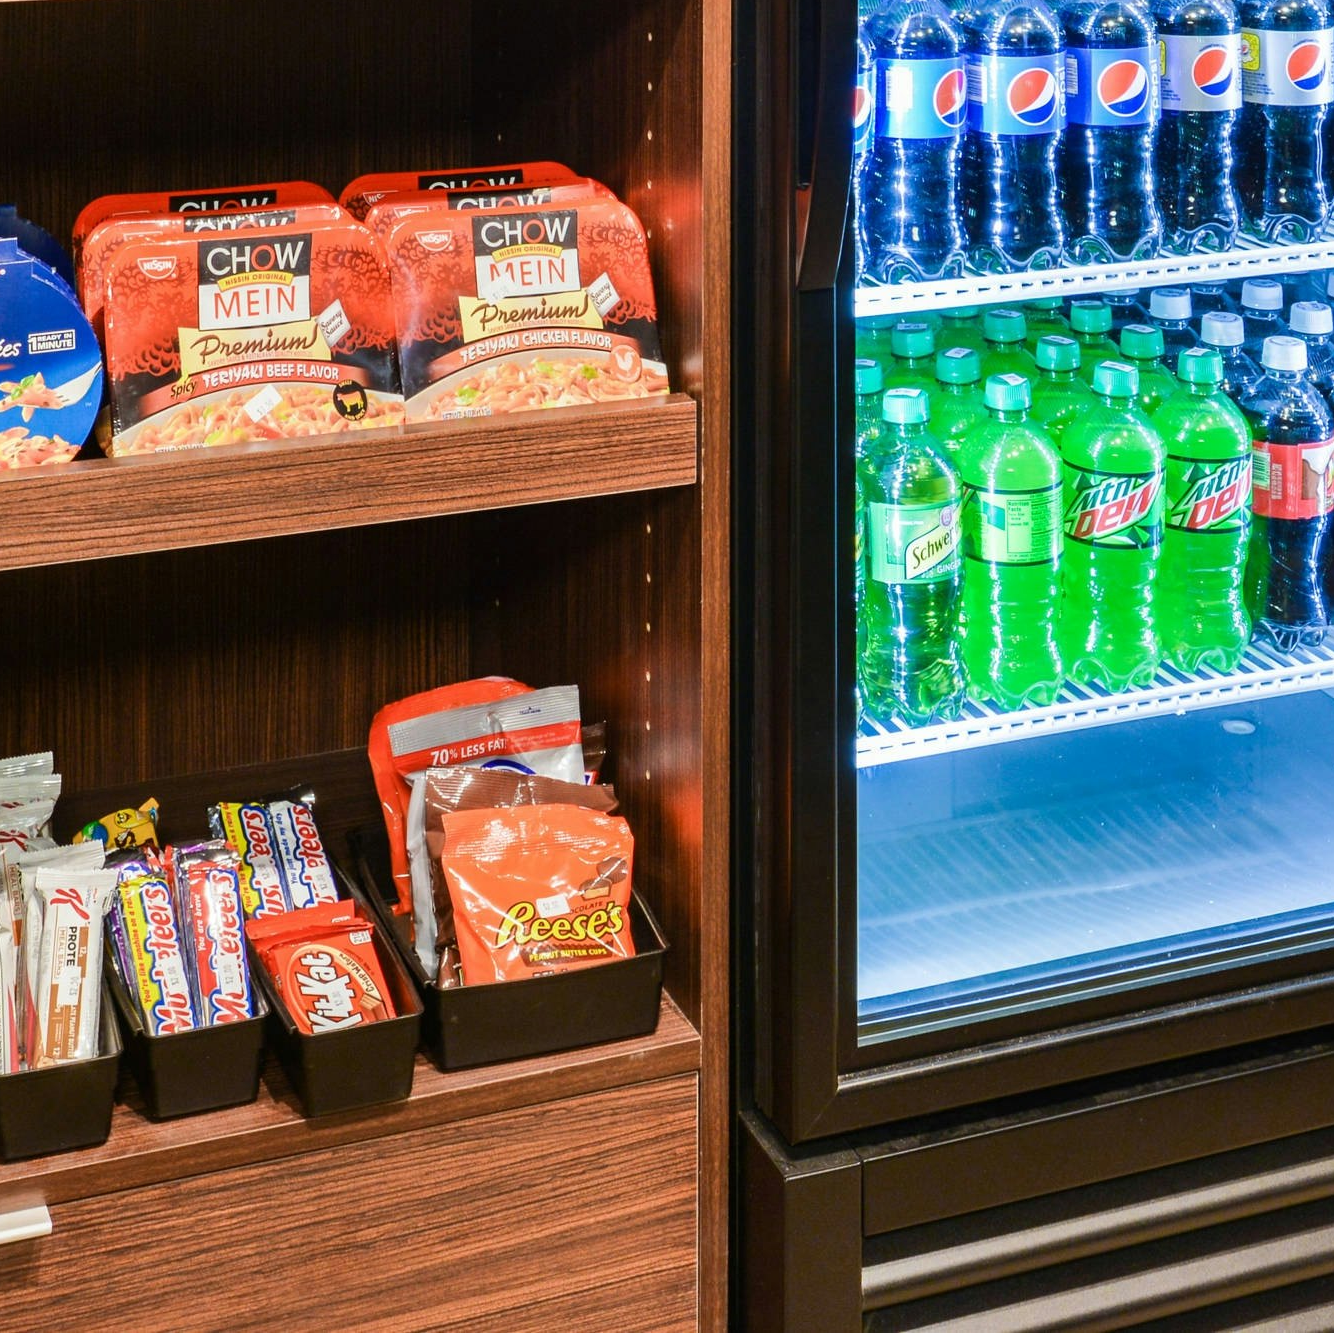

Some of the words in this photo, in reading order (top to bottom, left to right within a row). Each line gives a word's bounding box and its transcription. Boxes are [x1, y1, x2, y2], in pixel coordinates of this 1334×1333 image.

[481, 218, 571, 245] CHOW
[207, 241, 304, 275] CHOW
[225, 277, 250, 285] NISSIN
[252, 274, 287, 283] ORIGINAL
[214, 285, 295, 319] MEIN
[38, 333, 61, 342] READY
[38, 338, 73, 349] MINUTE
[460, 337, 520, 363] TERIYAKI
[522, 331, 569, 348] CHICKEN
[572, 331, 611, 349] FLAVOR
[202, 366, 264, 388] TERIYAKI
[266, 363, 294, 377] BEEF
[296, 364, 339, 380] FLAVOR
[170, 380, 197, 398] Spicy
[496, 900, 623, 948] Reese's
[529, 950, 558, 962] PEANUT
[560, 948, 587, 958] BUTTER
[589, 947, 606, 956] CUPS
